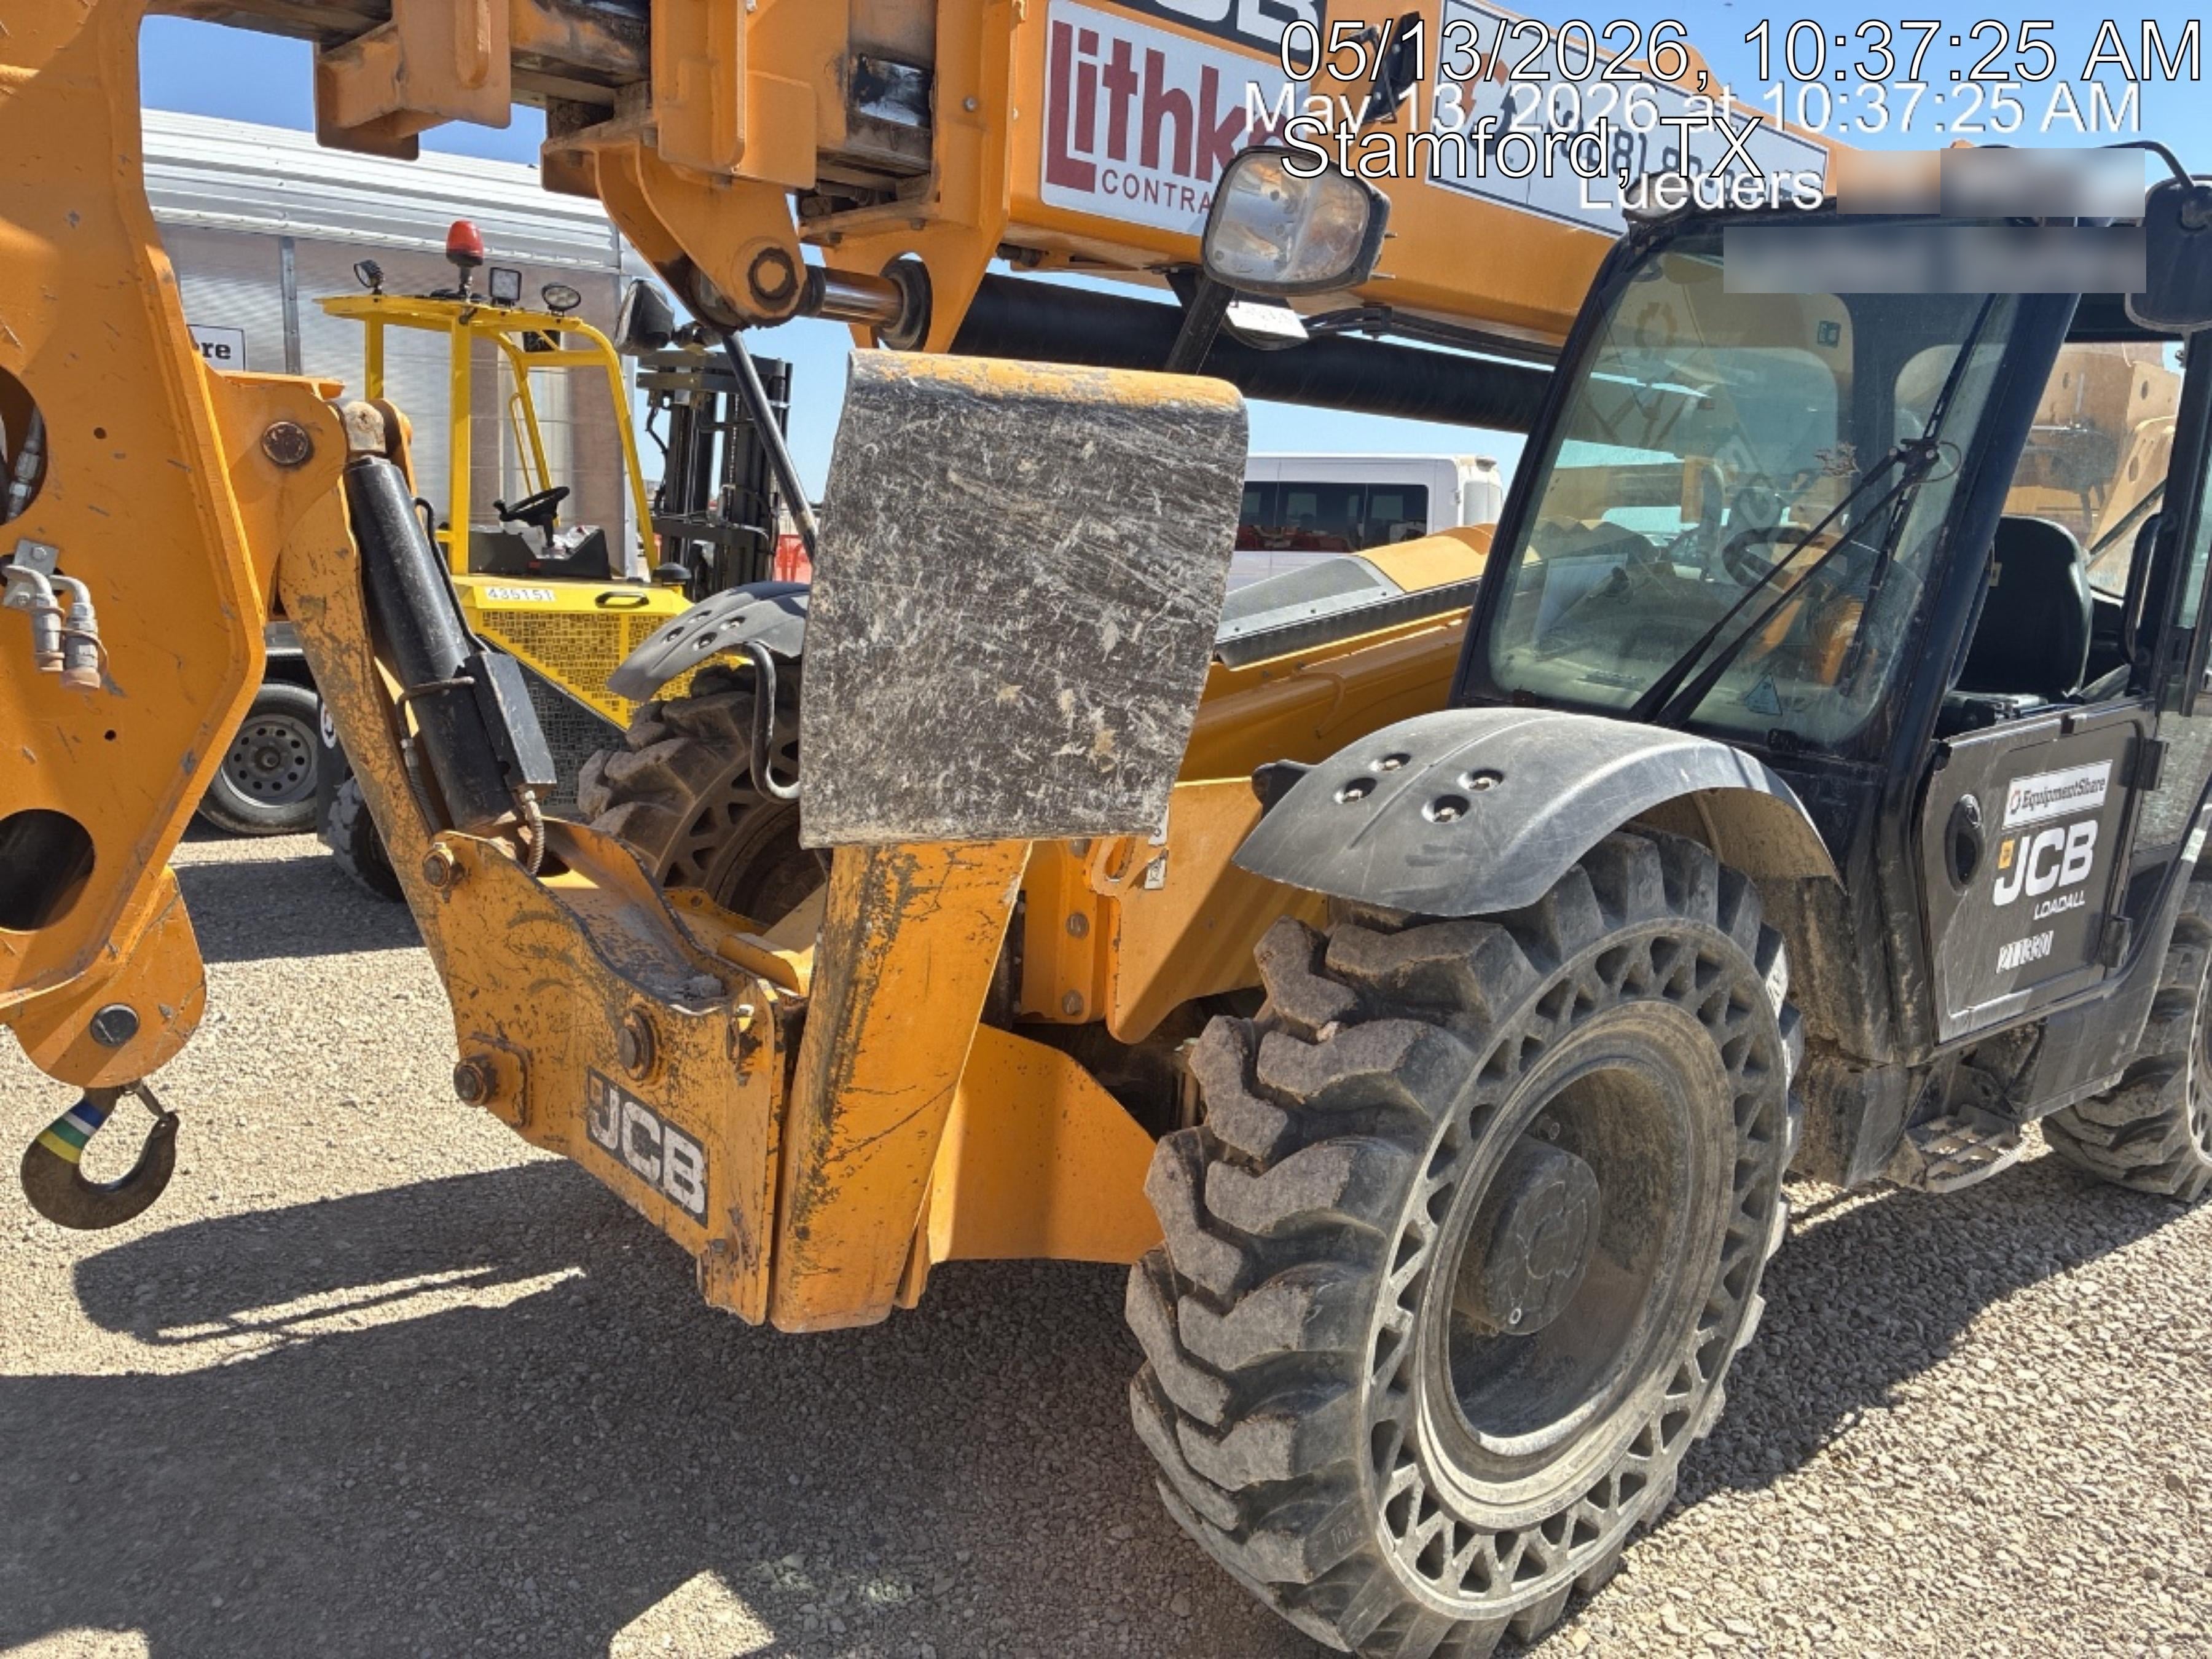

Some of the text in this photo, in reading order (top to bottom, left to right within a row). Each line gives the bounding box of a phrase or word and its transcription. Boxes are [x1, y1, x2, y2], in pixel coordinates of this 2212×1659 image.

[2022, 777, 2106, 811] EquipmentShare
[1993, 820, 2098, 906] JCB
[2033, 890, 2085, 920] LOADALL
[589, 1084, 705, 1214] JCB
